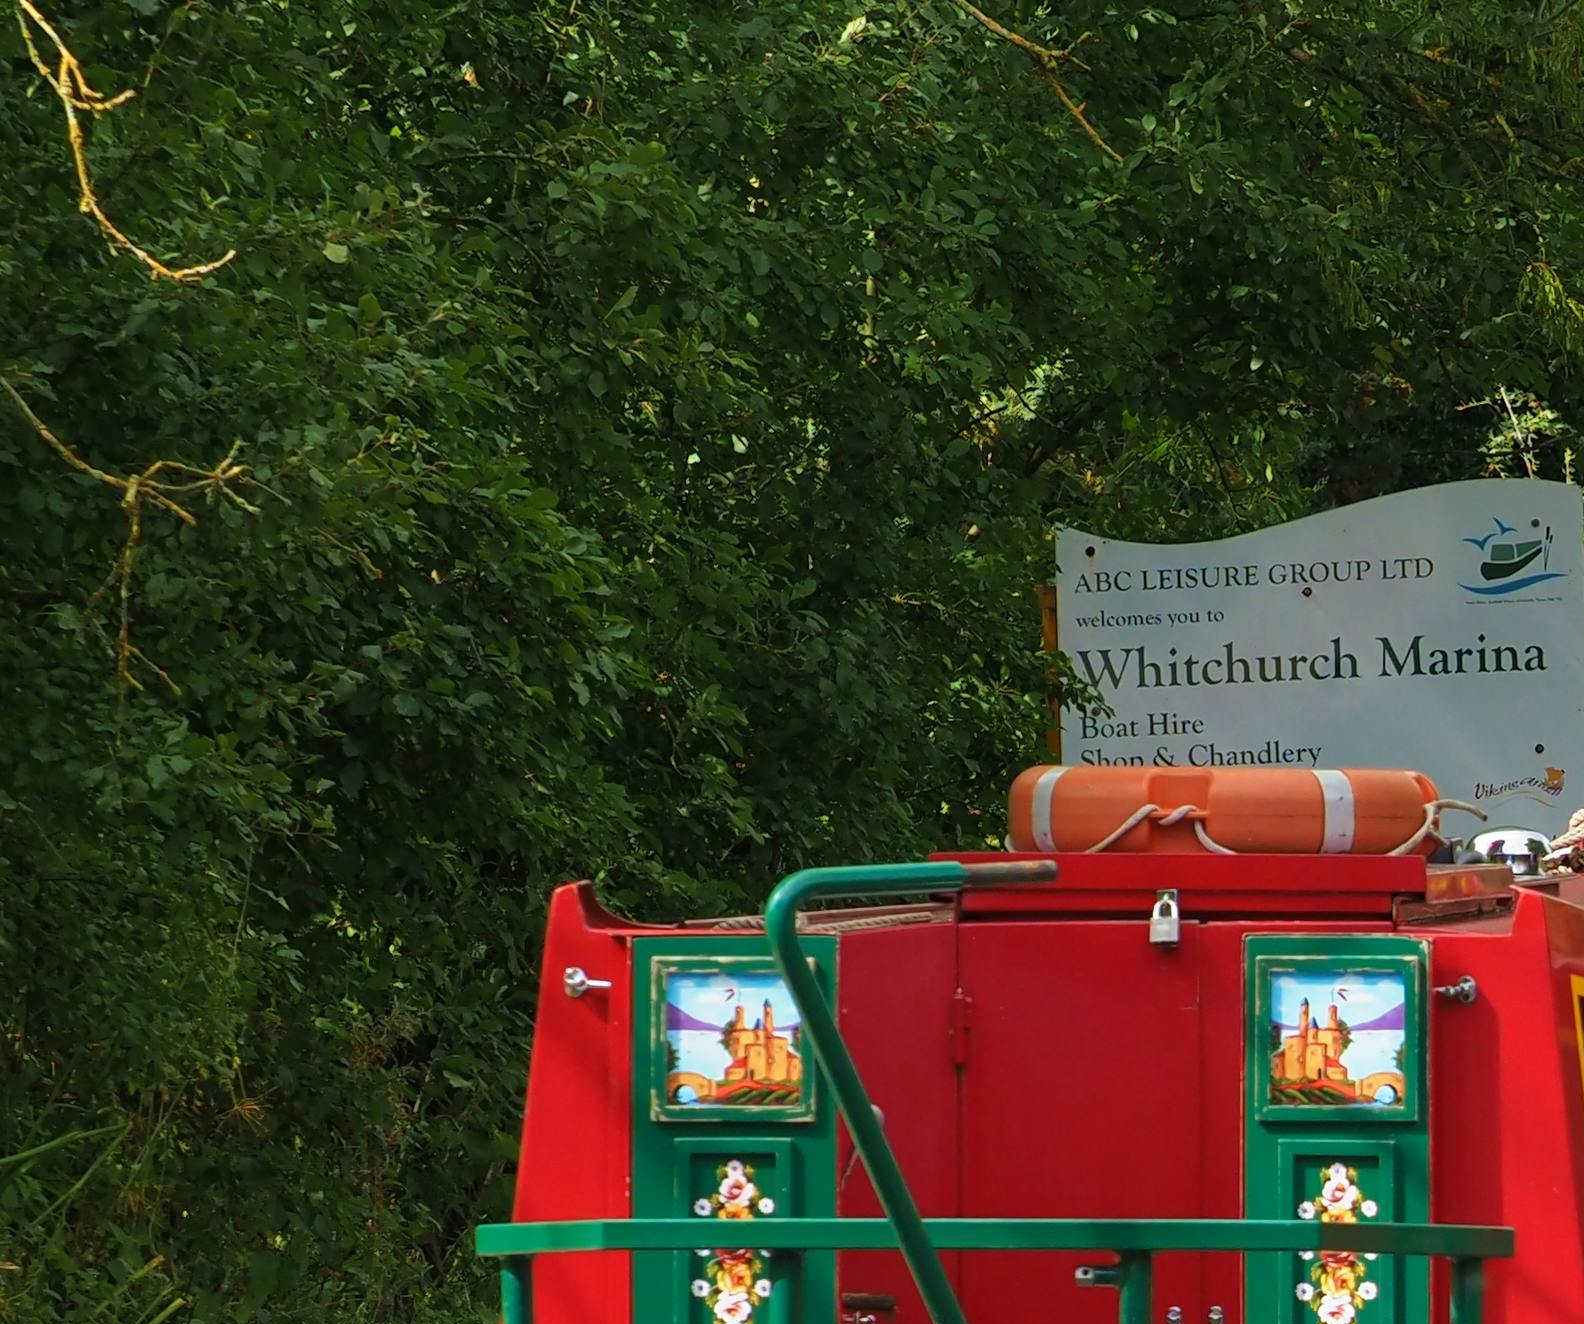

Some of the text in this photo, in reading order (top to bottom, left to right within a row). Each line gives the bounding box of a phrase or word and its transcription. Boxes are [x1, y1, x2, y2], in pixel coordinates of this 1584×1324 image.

[1074, 557, 1434, 594] ABC LEISURE GROUP LTD
[1076, 608, 1225, 628] welcomes you to
[1076, 633, 1549, 690] Whitchurch Marina
[1079, 712, 1205, 740] Boat Hire
[1152, 746, 1175, 767] &
[1188, 740, 1323, 768] Chandlery
